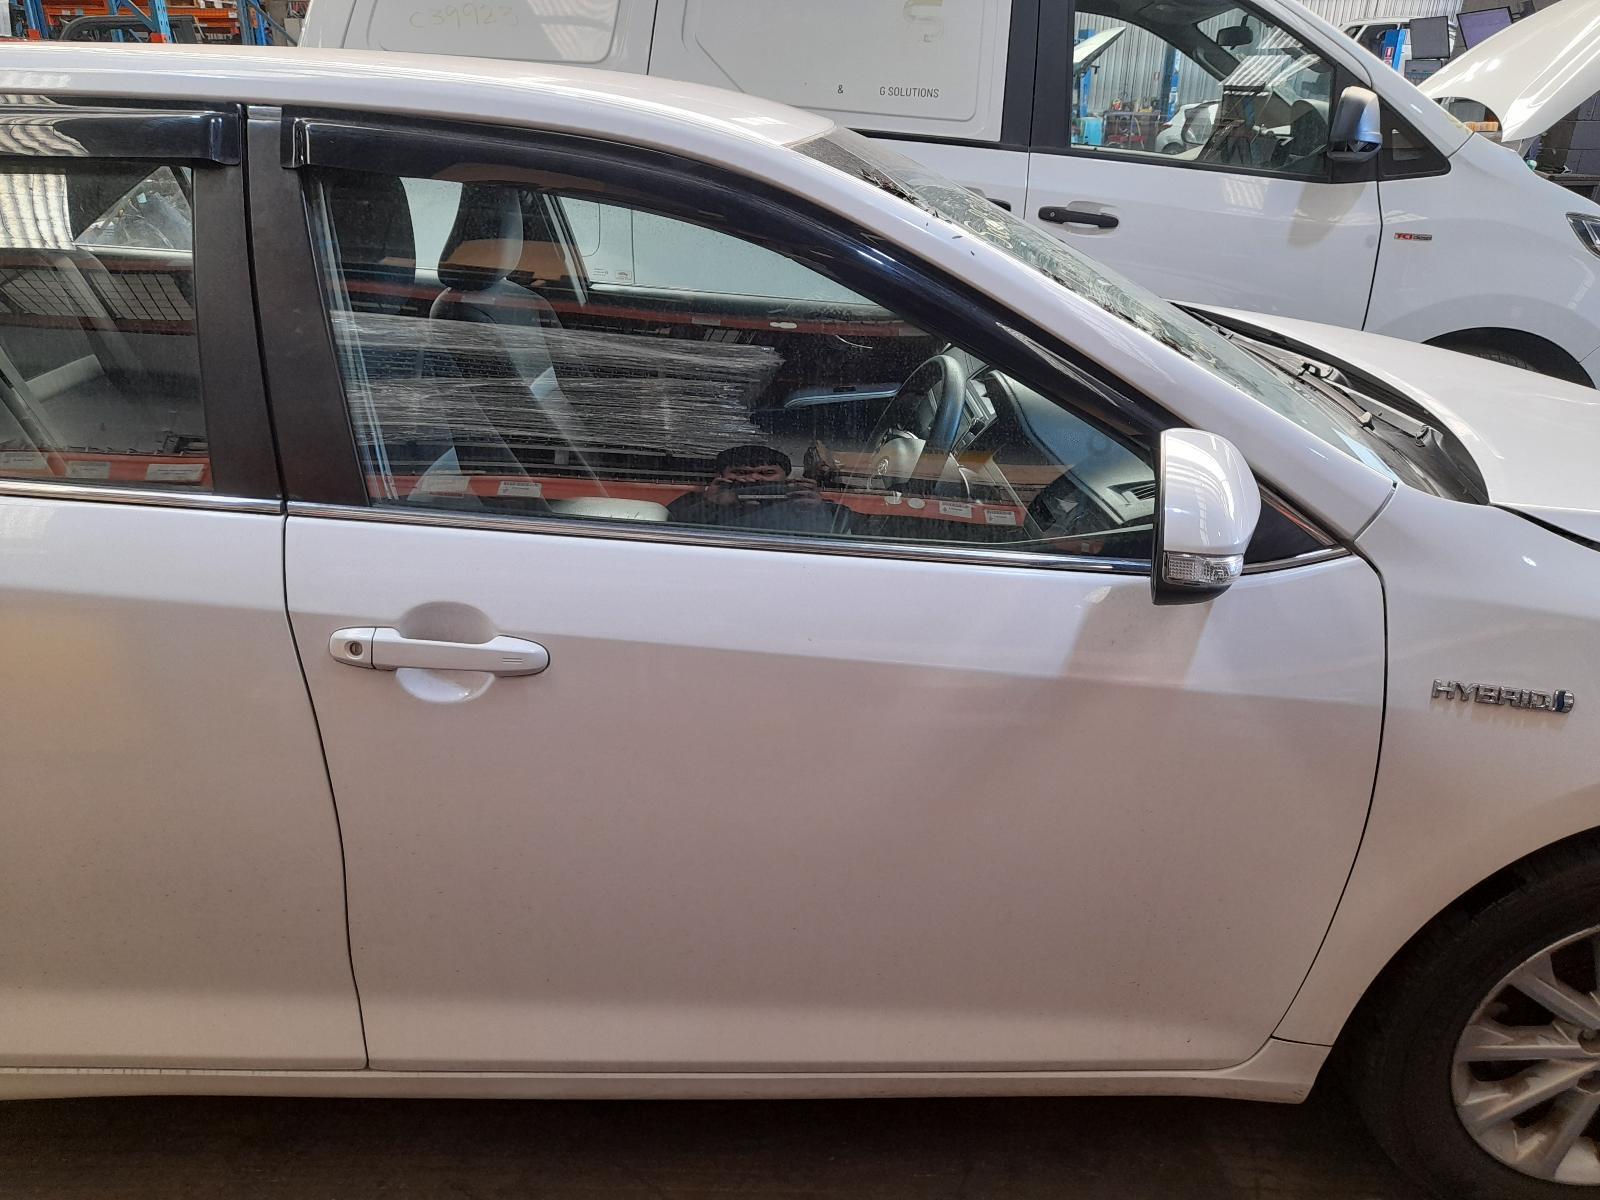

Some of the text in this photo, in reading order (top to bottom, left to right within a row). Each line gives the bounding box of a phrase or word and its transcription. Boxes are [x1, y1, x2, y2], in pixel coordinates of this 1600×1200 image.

[837, 84, 844, 94] &
[887, 86, 940, 98] SOLUTIONS
[1431, 679, 1552, 711] HYBRID
